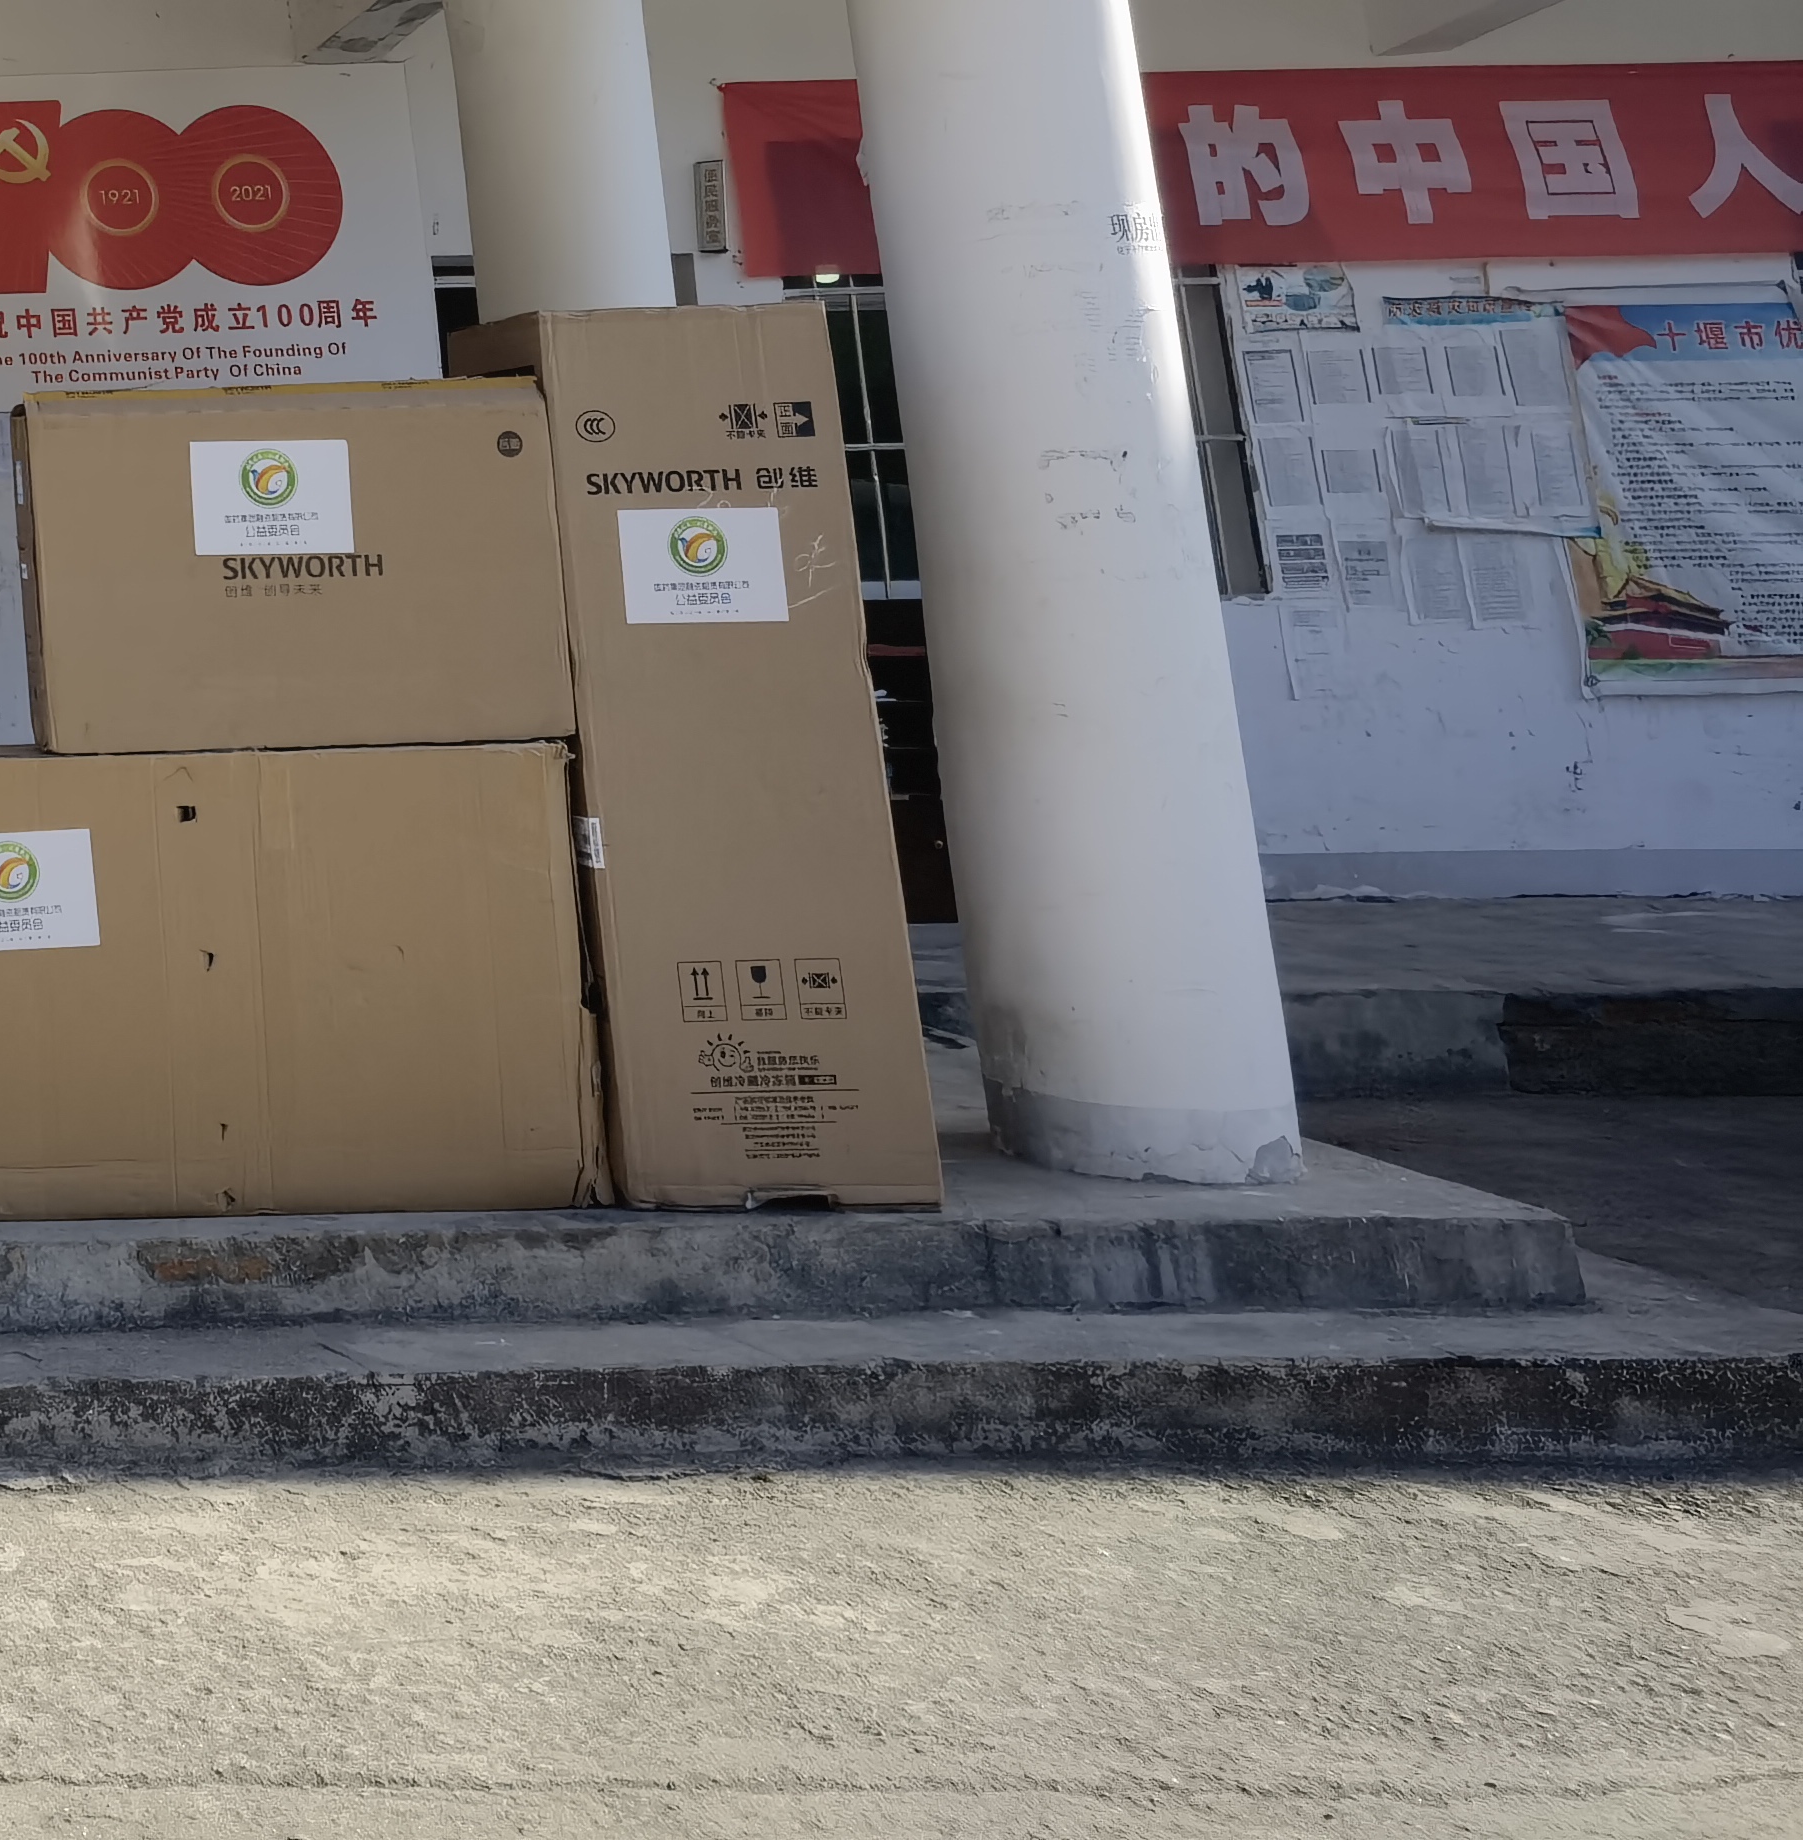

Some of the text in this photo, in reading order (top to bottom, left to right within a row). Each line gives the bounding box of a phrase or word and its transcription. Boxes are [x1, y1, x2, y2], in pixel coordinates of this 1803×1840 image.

[99, 189, 140, 206] 1921
[229, 183, 272, 201] 2021
[18, 349, 67, 367] 100th
[72, 347, 178, 366] Anniversary
[183, 345, 202, 361] Of
[206, 344, 239, 360] The
[242, 343, 324, 363] Founding
[327, 342, 347, 357] Of
[32, 362, 303, 385] The Communist Party Of China
[586, 465, 819, 496] SKYWORTH 创维
[222, 553, 385, 581] SKYWORTH
